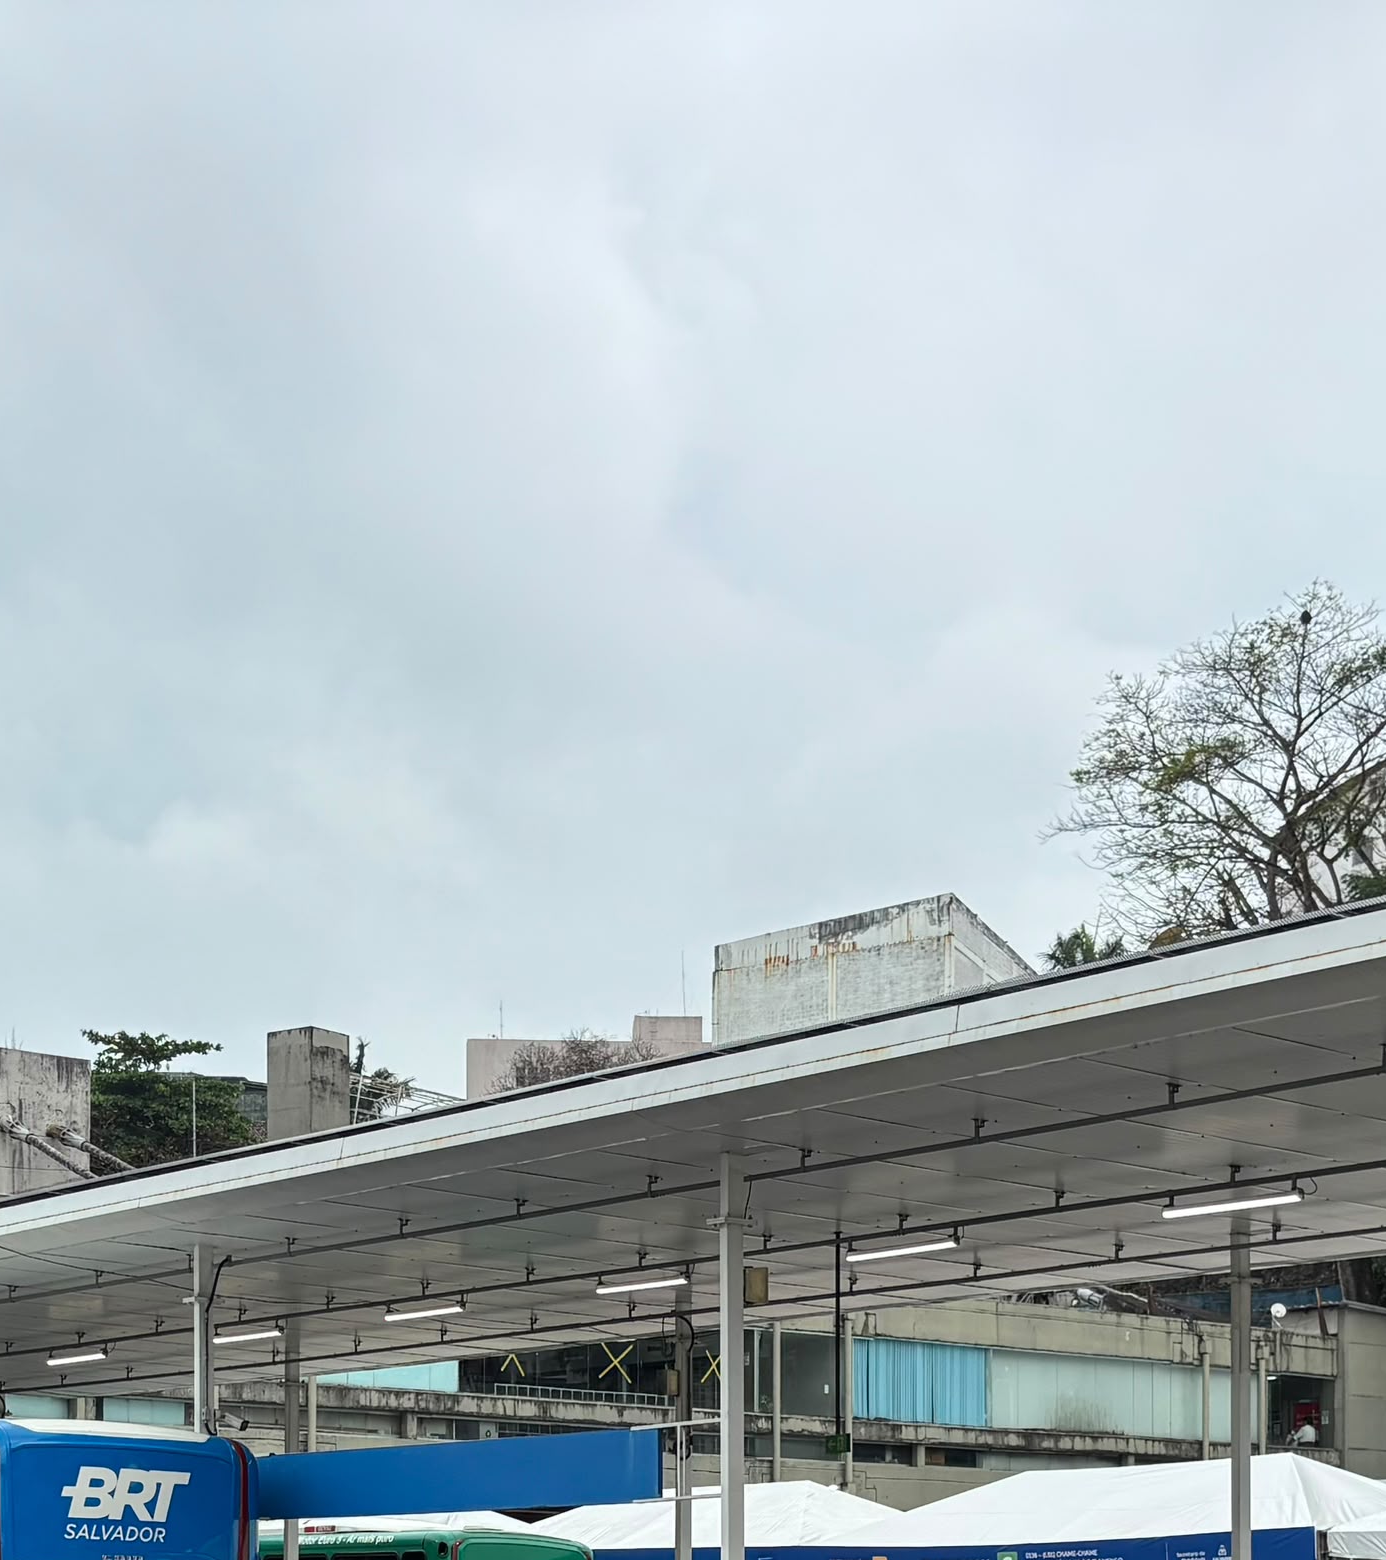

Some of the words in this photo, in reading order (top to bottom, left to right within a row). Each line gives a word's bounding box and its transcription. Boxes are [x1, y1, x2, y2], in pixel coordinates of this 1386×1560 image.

[61, 1465, 191, 1523] BRT
[64, 1523, 166, 1543] SALVADOR
[375, 1534, 394, 1545] puro
